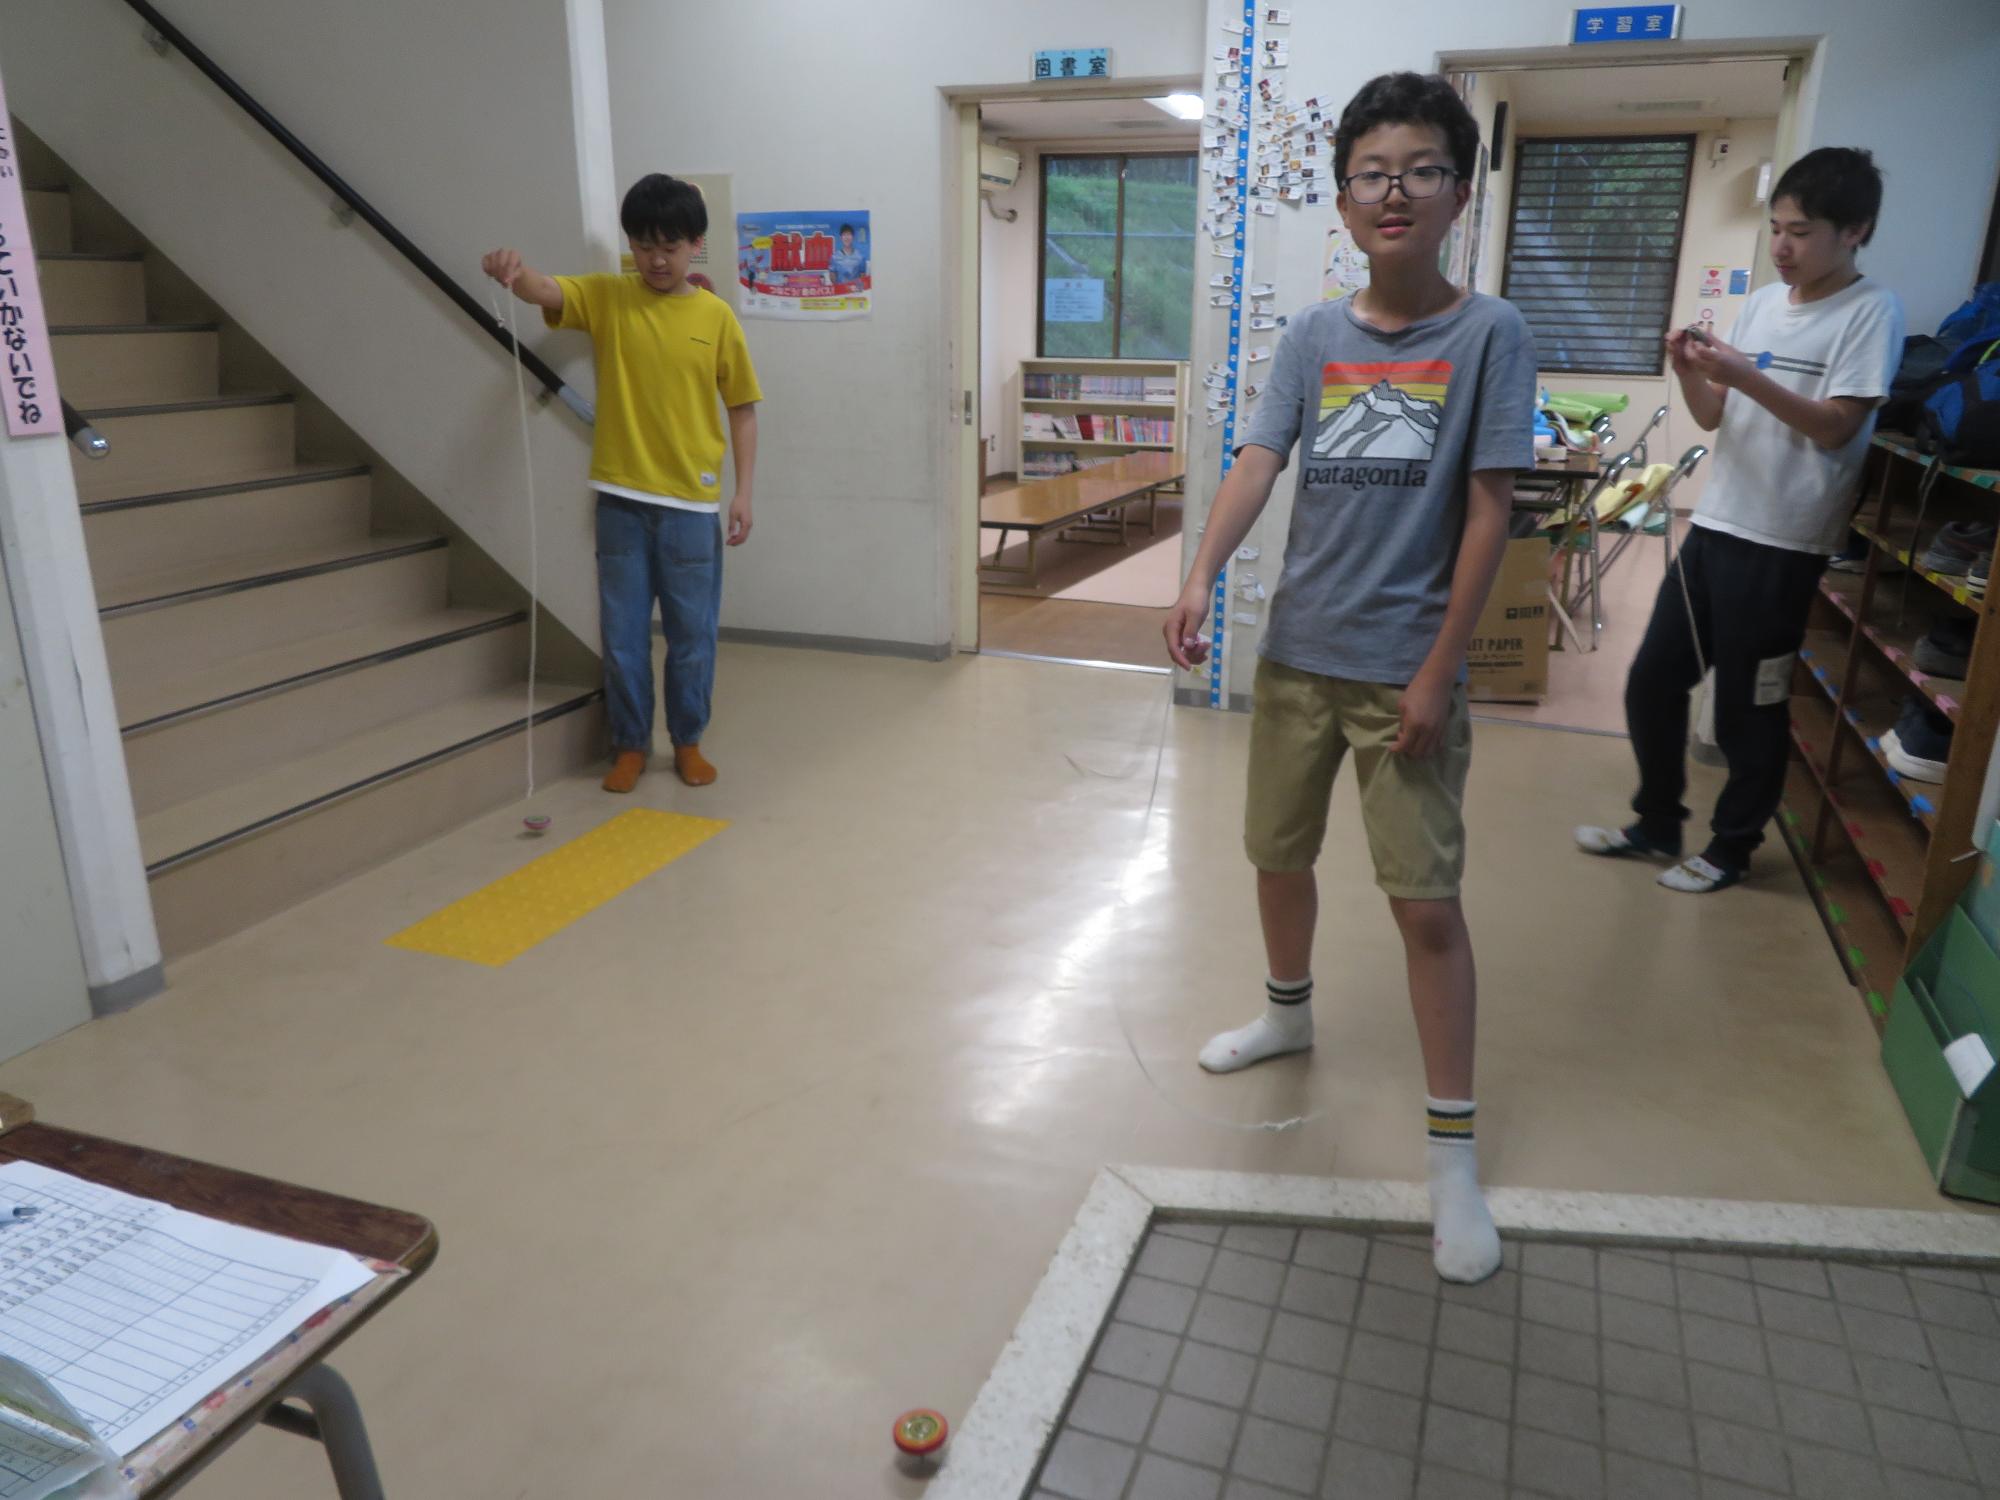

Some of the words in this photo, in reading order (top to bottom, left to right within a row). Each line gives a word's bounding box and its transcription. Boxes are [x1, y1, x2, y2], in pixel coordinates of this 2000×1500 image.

[1586, 14, 1664, 34] 学習室
[770, 232, 834, 272] 献血
[1302, 462, 1428, 491] patagonia
[1487, 637, 1523, 651] PAPER
